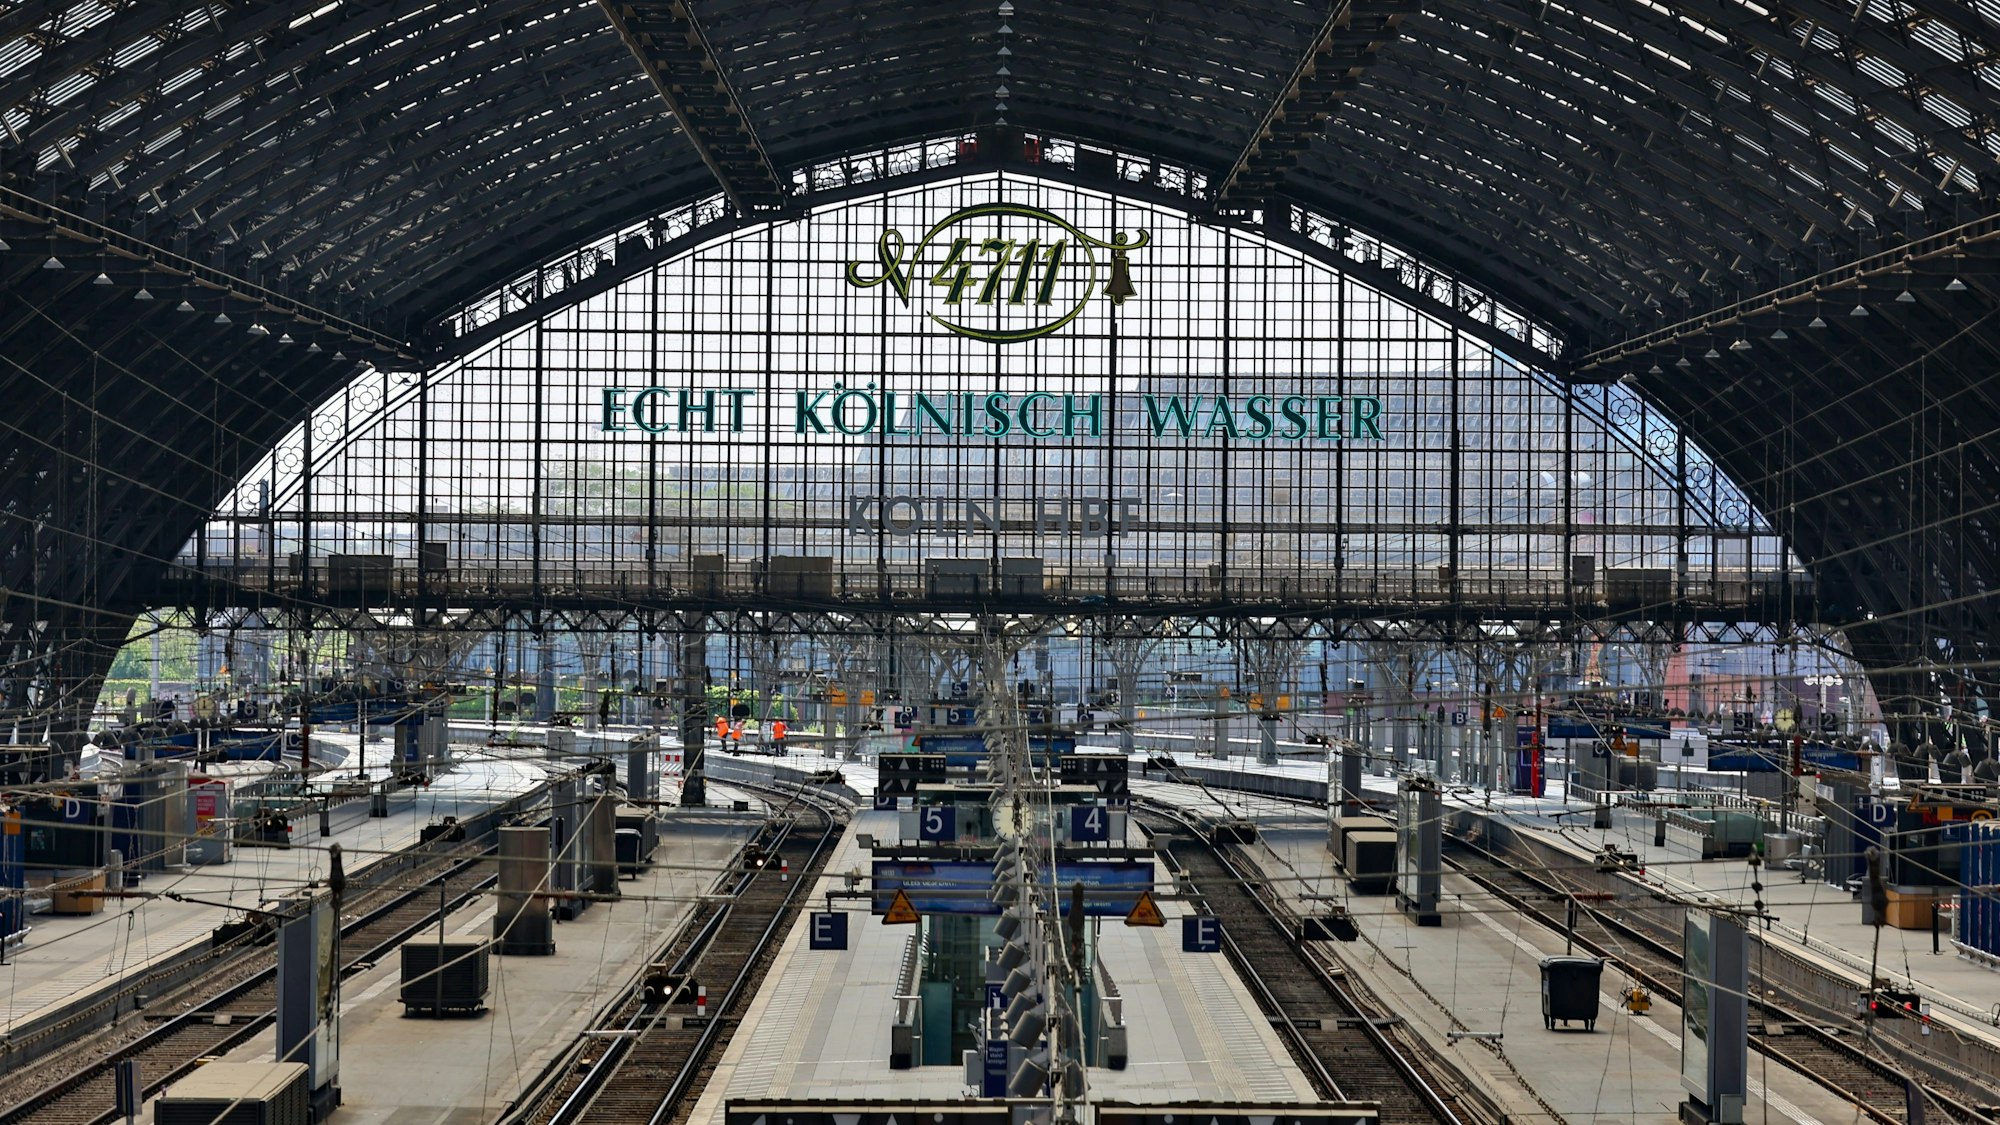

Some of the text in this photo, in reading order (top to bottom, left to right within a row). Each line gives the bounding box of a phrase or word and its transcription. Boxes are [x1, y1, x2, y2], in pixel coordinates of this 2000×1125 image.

[929, 238, 1069, 306] 4711
[602, 381, 1385, 441] ECHT KÖLNISCH WASSER
[849, 495, 1142, 539] KÖLN HBF
[954, 682, 963, 695] 5
[244, 702, 254, 716] 6
[950, 709, 960, 722] 5
[900, 713, 911, 725] C
[1456, 713, 1464, 724] B
[1736, 713, 1746, 727] 3
[1824, 714, 1834, 728] 2
[66, 799, 80, 818] D
[1872, 804, 1887, 822] D
[925, 807, 943, 834] 5
[1084, 807, 1102, 834] 4
[814, 913, 832, 942] E
[1198, 917, 1215, 944] E
